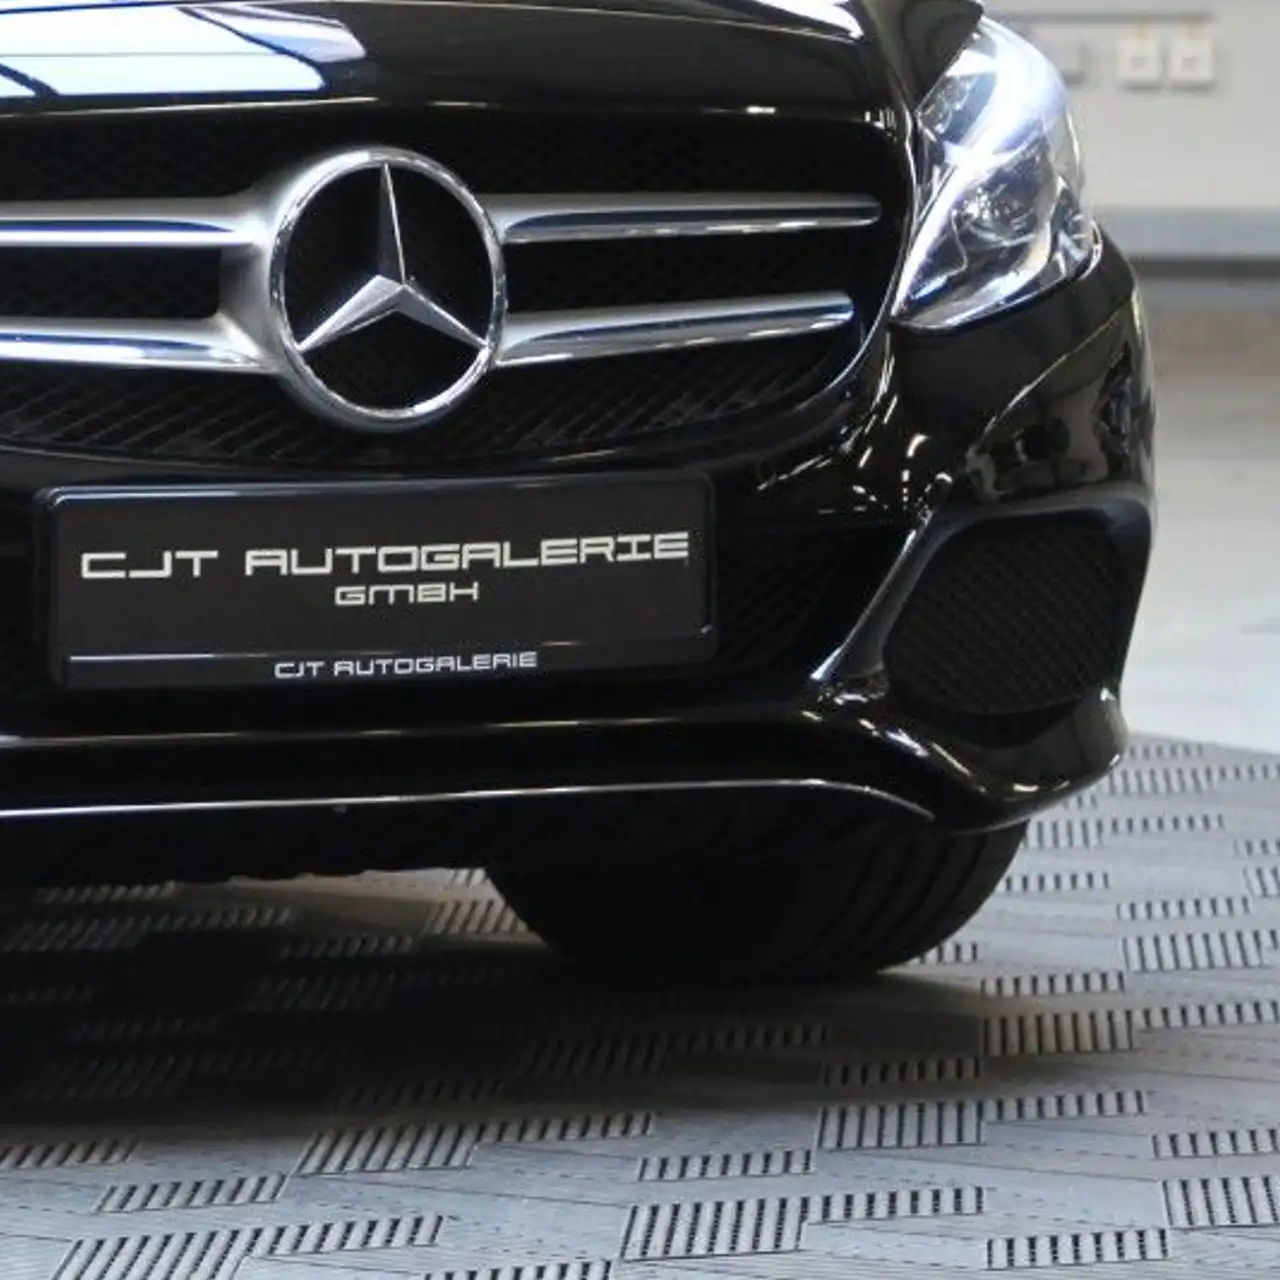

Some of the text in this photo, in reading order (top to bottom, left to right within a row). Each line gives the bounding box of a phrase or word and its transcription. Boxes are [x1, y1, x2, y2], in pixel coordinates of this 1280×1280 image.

[79, 531, 690, 580] CJT AUTOGALERIE
[274, 650, 539, 680] CJT AUTOGALERIE
